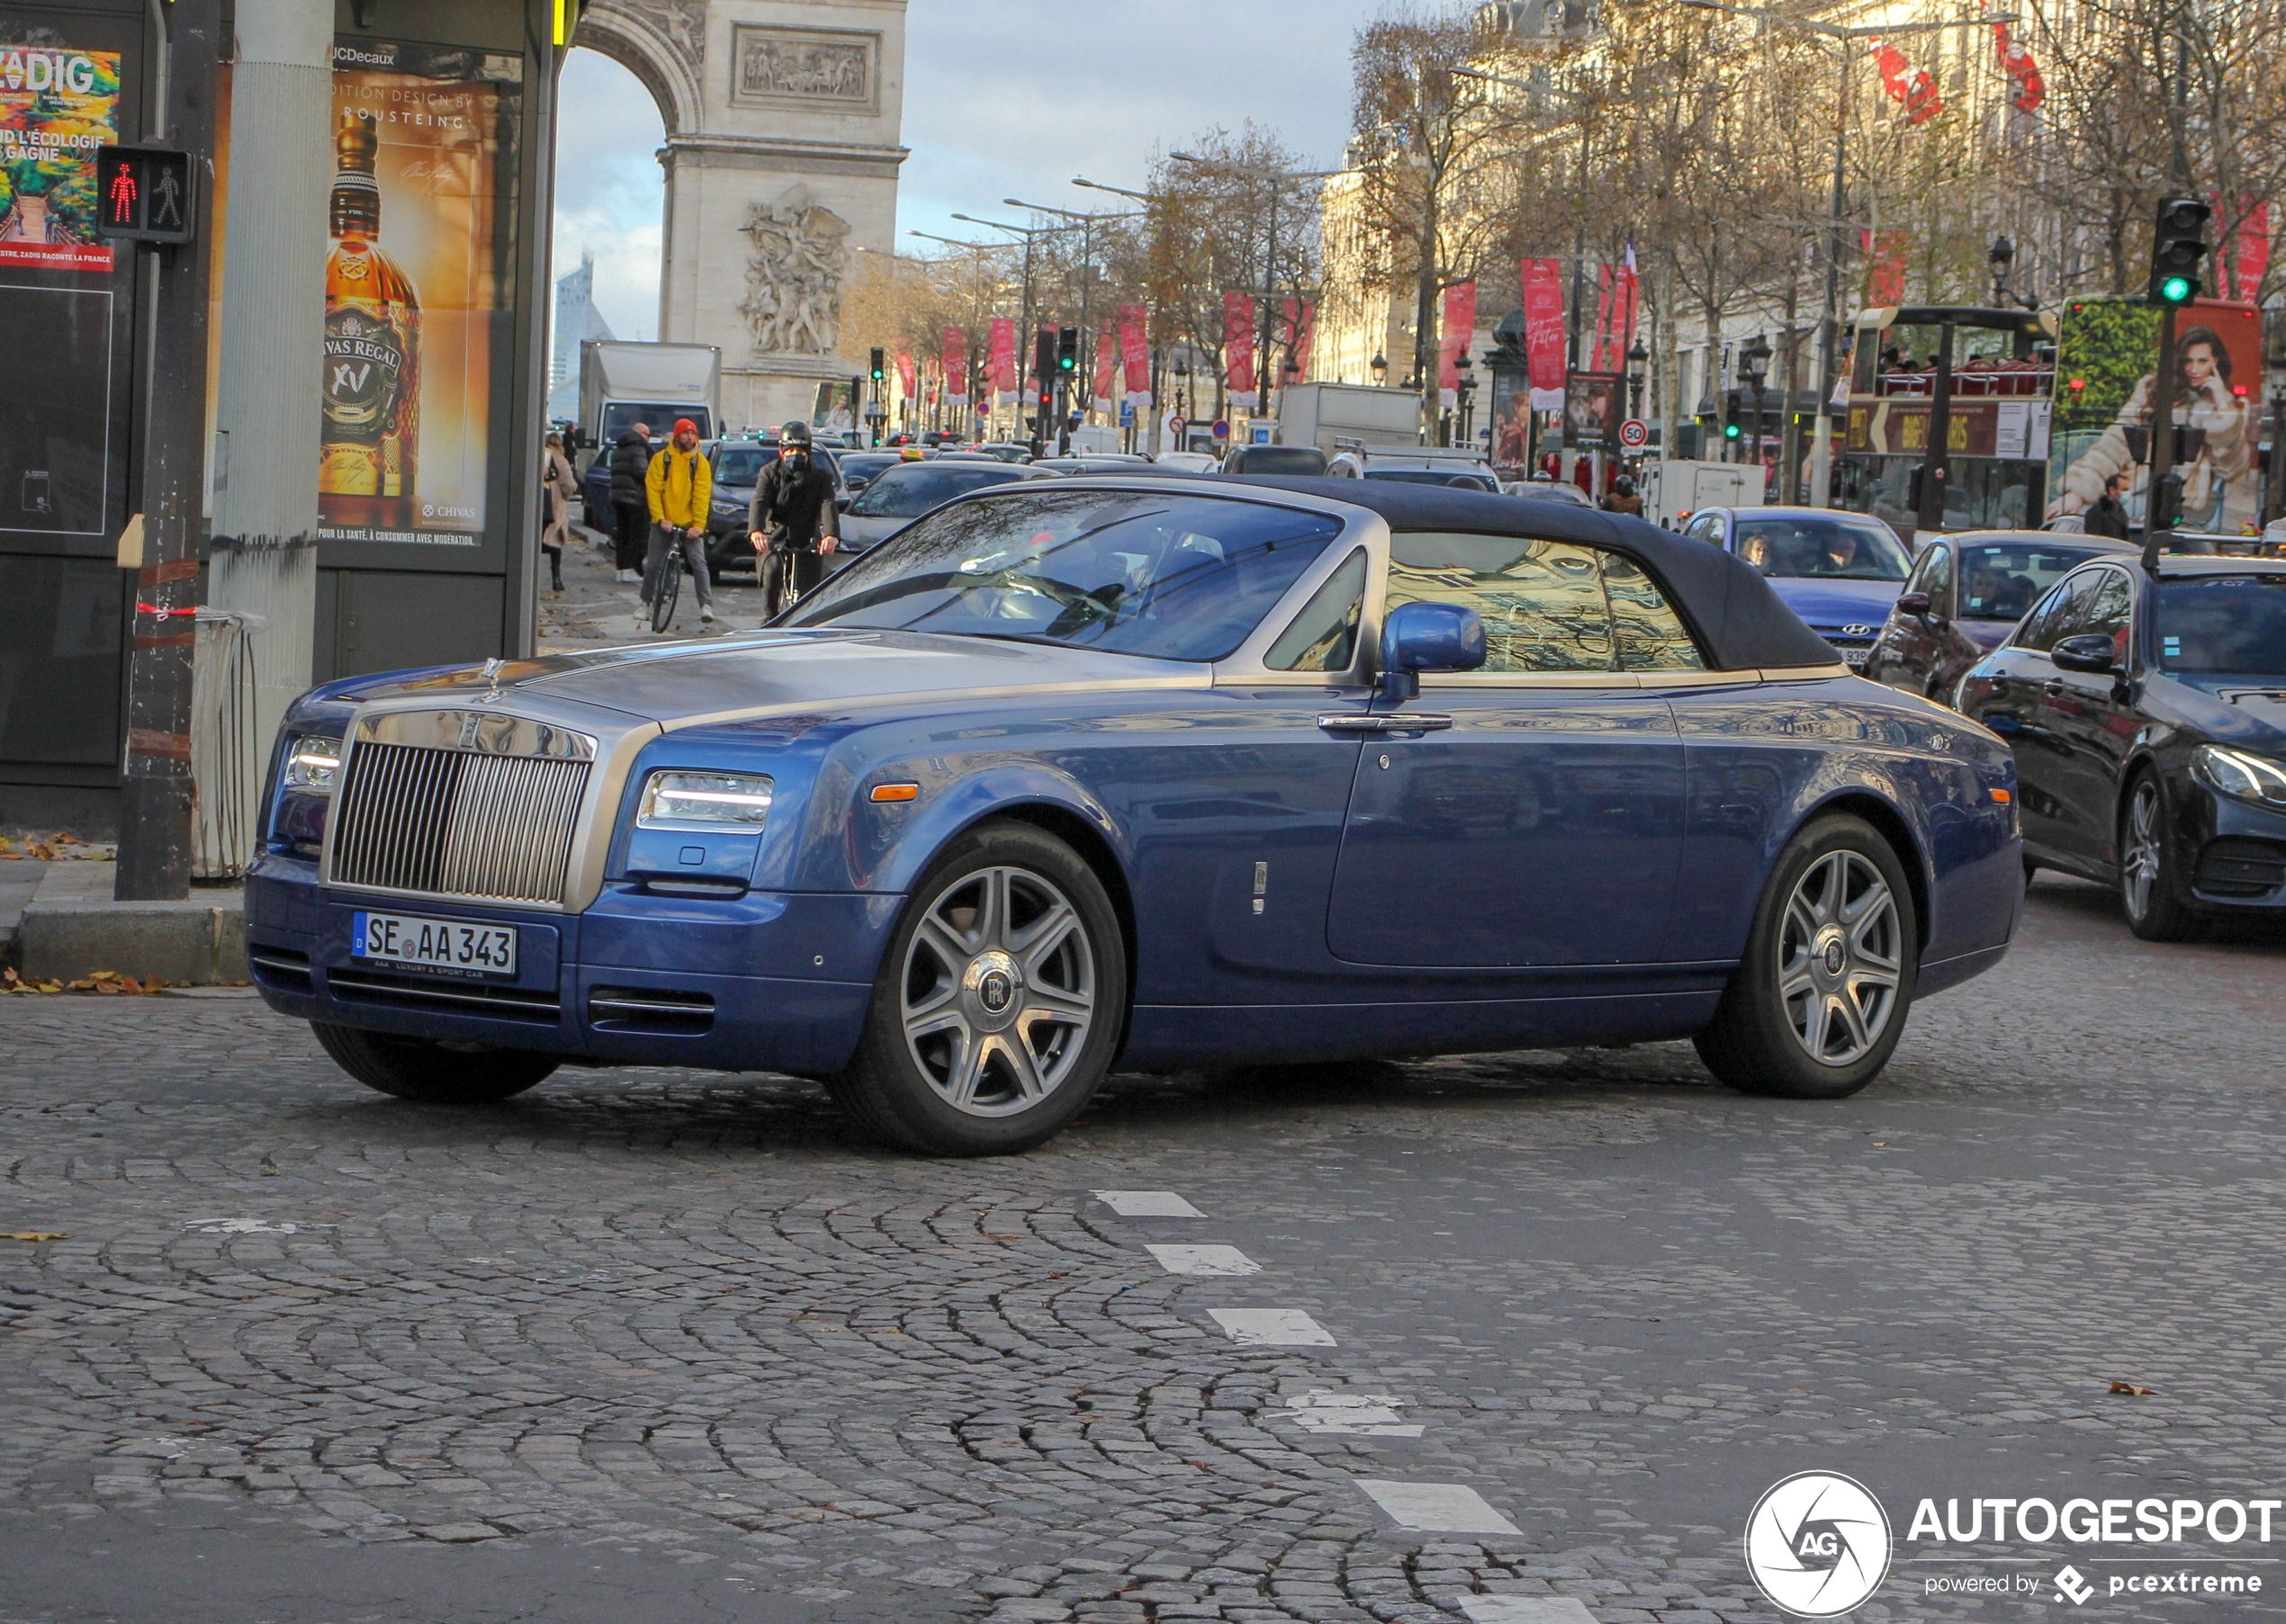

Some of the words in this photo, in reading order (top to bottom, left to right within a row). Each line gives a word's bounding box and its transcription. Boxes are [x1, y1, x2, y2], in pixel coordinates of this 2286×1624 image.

[333, 46, 394, 66] JCDecaux
[0, 51, 94, 94] ADIG
[392, 90, 448, 107] DESIGN
[456, 98, 472, 109] BY
[345, 106, 463, 130] ROUSTEING
[6, 145, 59, 161] GAGNE
[20, 251, 40, 259] ZADIG
[42, 252, 73, 261] RACONTE
[84, 255, 111, 263] FRANCE
[355, 340, 397, 368] REGAL
[332, 363, 371, 395] XV
[1626, 427, 1642, 439] 50
[437, 507, 475, 518] CHIVAS
[318, 528, 335, 538] POUR
[337, 529, 345, 539] LA
[346, 528, 368, 540] SANTÉ,
[369, 528, 374, 540] À
[375, 531, 415, 543] CONSOMMER
[417, 534, 432, 543] AVEC
[434, 533, 475, 545] MODÉRATION.
[368, 919, 400, 956] SE
[418, 924, 452, 962] AA
[458, 928, 510, 967] 343
[396, 963, 426, 972] LUXURY
[437, 968, 464, 977] SPORT
[466, 971, 484, 979] CAR
